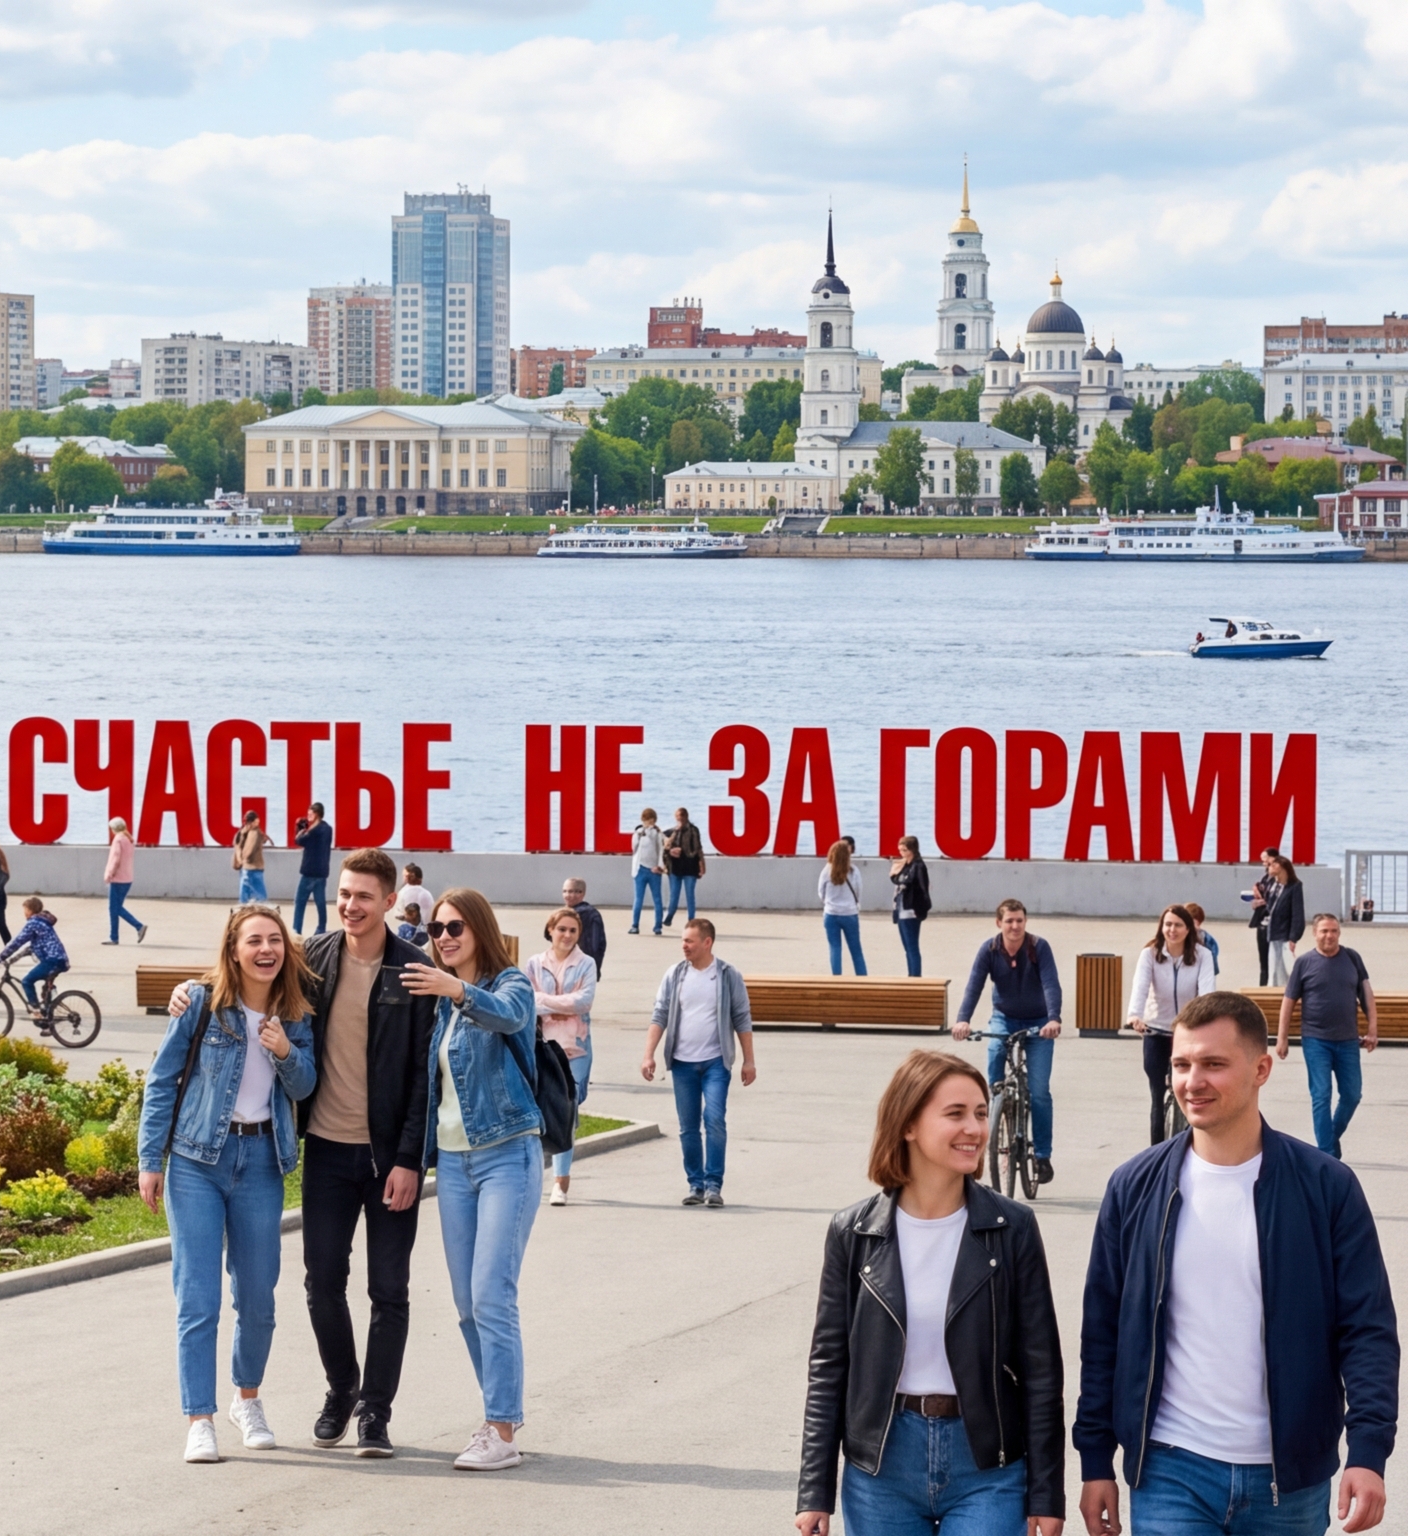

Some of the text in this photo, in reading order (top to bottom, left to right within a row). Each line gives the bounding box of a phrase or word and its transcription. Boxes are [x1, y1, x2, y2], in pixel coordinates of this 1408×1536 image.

[8, 717, 1318, 865] СЧАСТЬЕ НЕ ЗА ГОРАМИ
